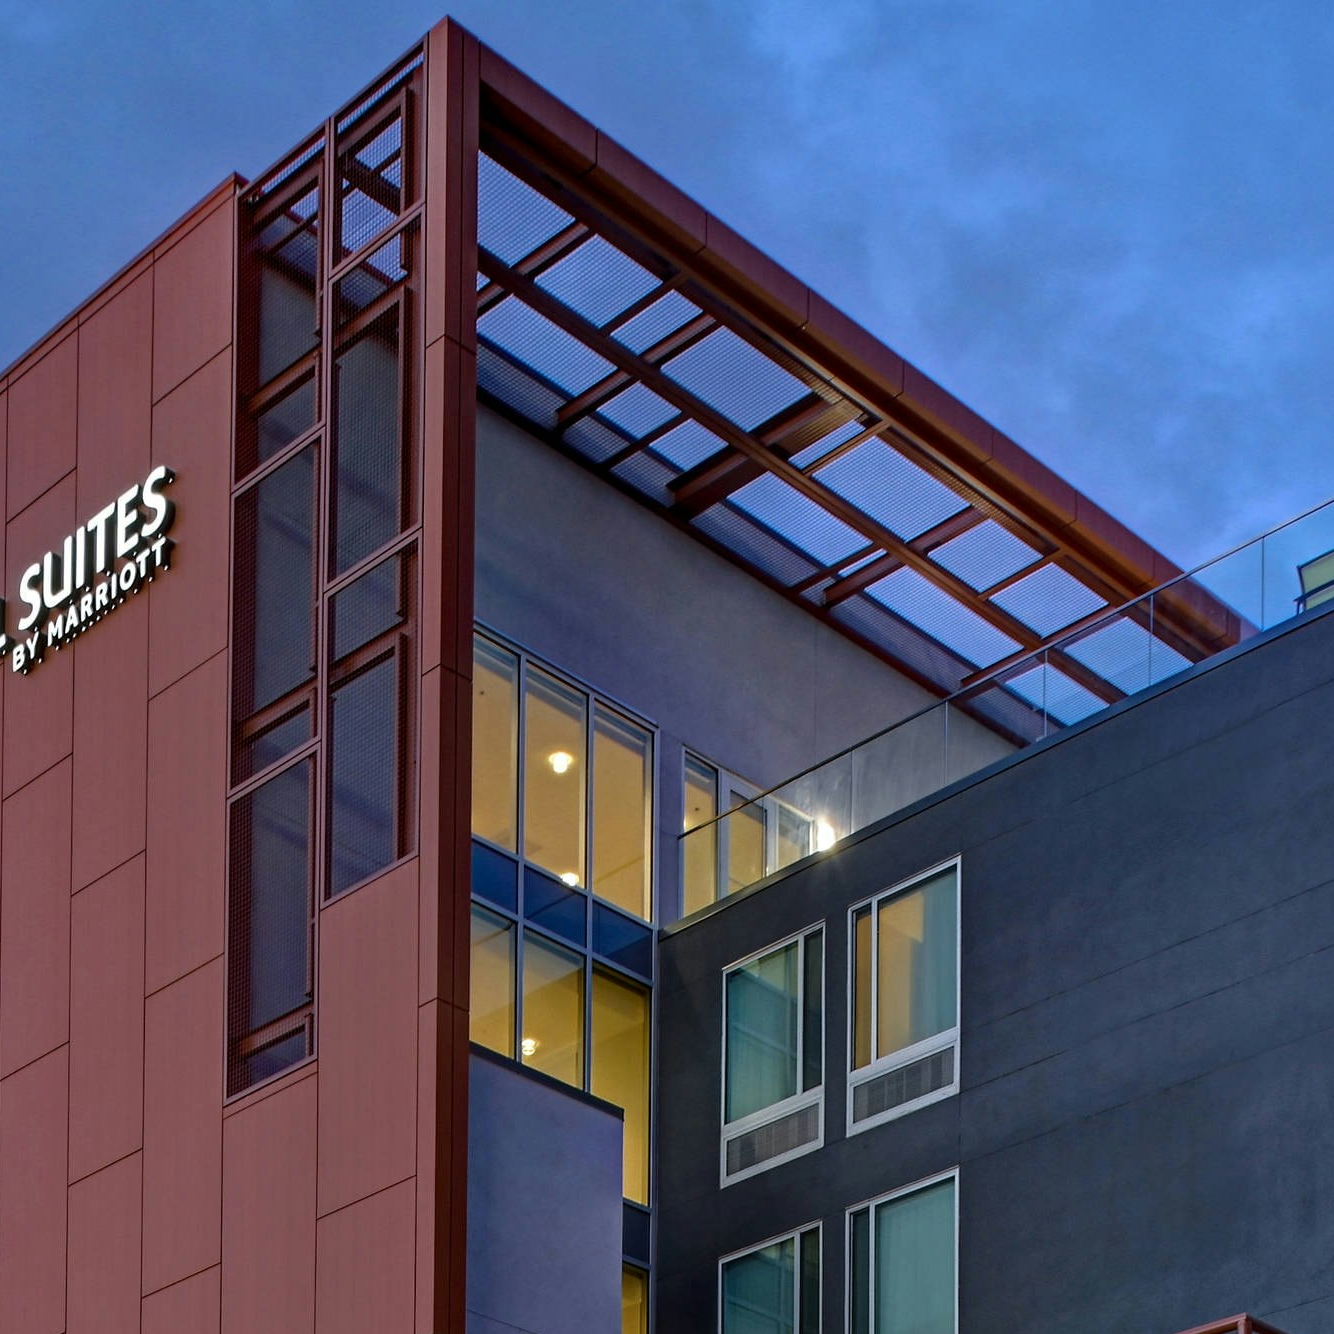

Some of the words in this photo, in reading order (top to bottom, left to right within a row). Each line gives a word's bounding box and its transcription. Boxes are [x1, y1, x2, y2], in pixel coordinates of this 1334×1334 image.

[12, 630, 40, 673] BY
[47, 535, 167, 647] MARRIOTT
[18, 465, 167, 631] SUITES
